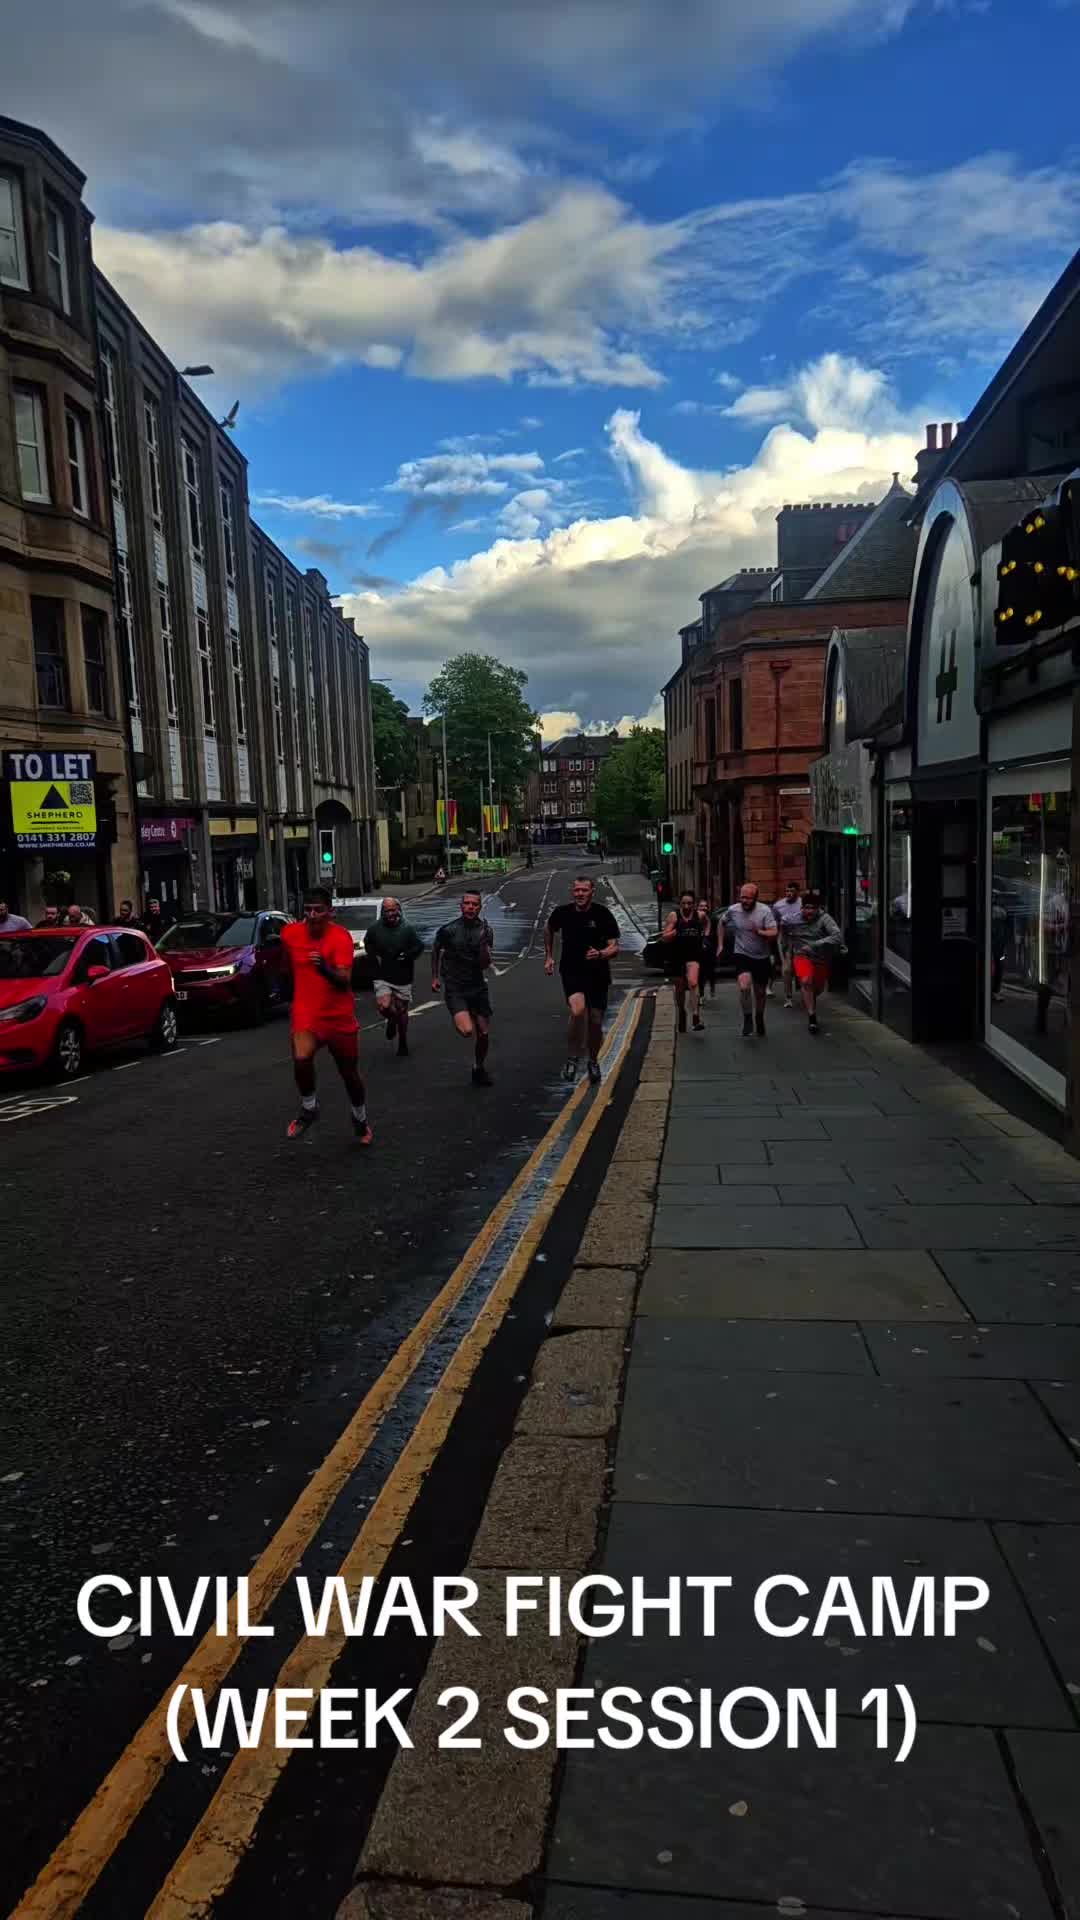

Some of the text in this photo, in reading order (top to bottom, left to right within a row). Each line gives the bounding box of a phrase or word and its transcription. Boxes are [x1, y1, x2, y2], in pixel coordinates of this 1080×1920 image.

[10, 754, 91, 779] TO LET
[26, 811, 84, 819] SHEPHERD
[17, 833, 96, 842] 0141 331 2807
